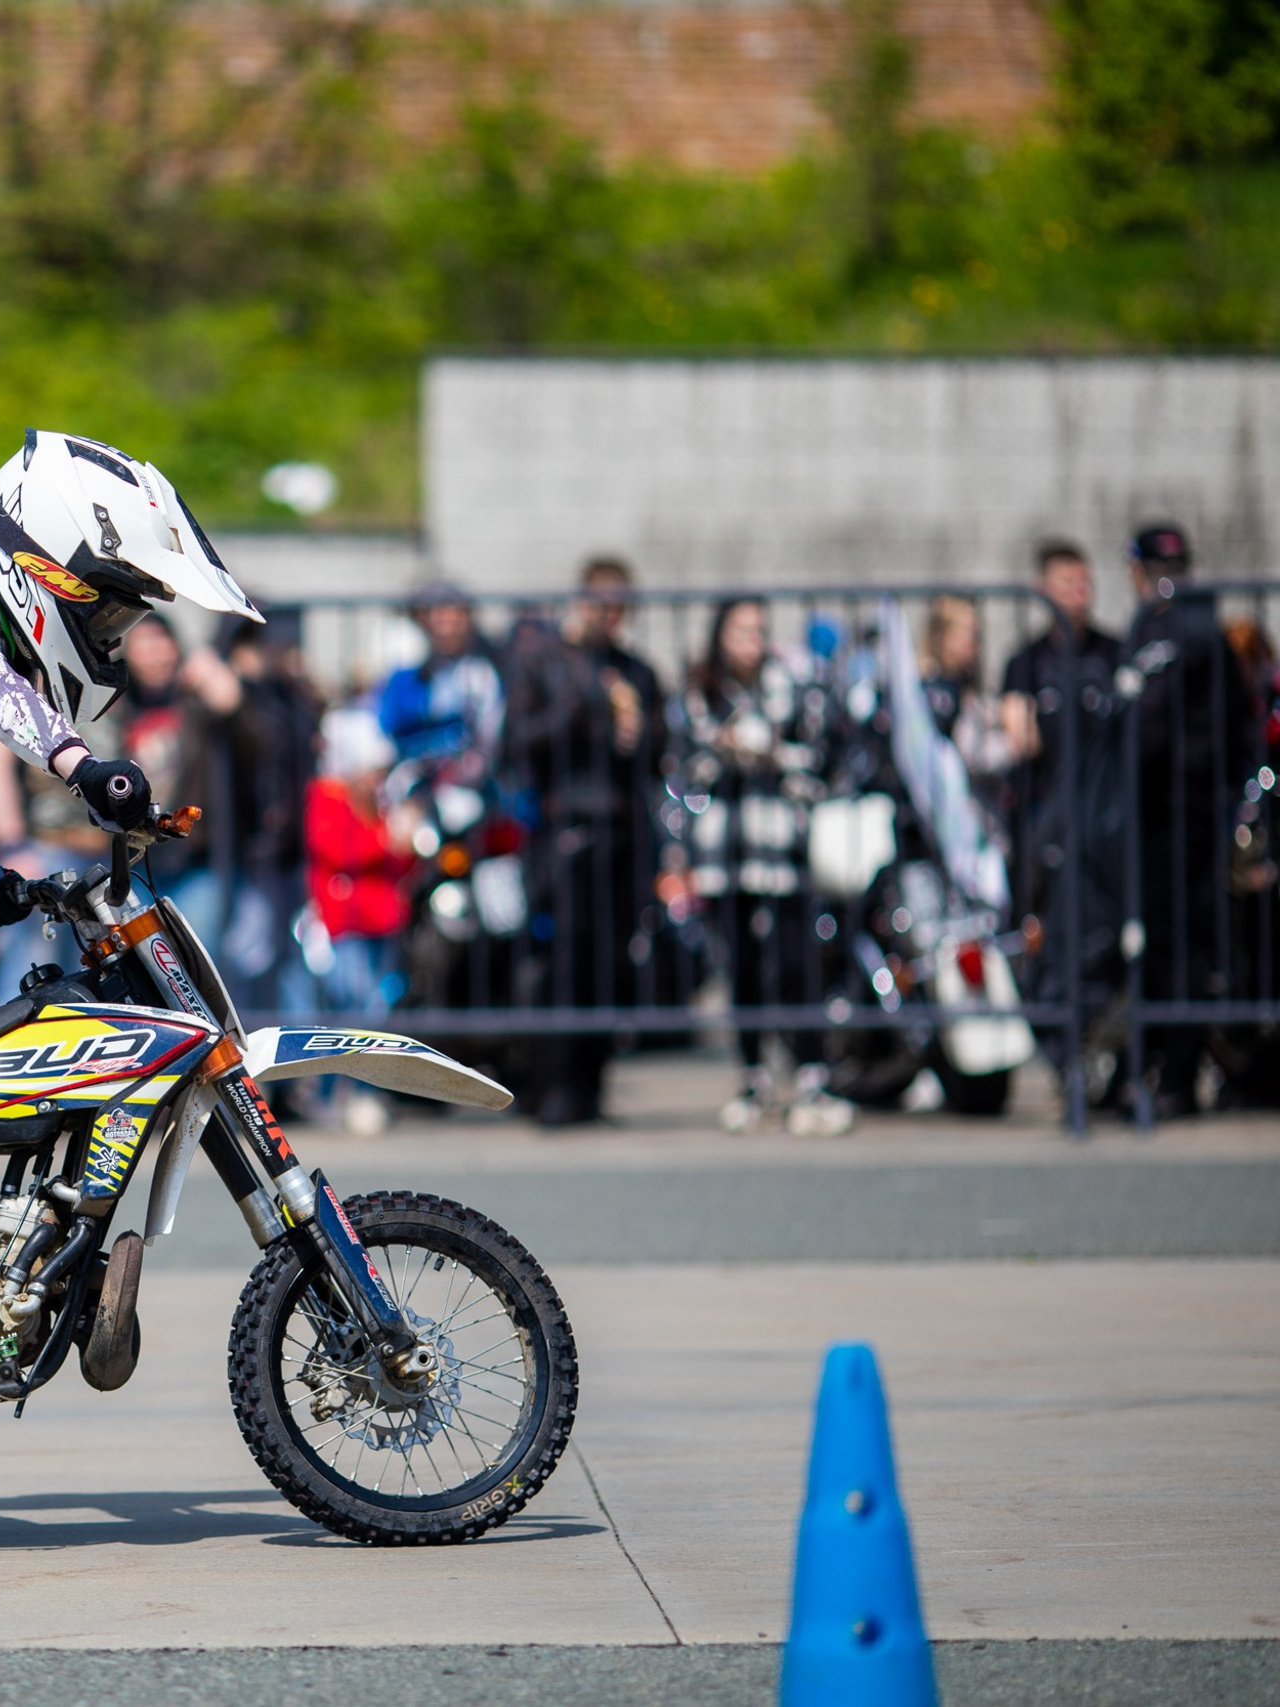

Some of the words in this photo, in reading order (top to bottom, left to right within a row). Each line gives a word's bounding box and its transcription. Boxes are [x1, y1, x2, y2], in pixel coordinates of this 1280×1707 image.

[14, 552, 99, 600] FMF
[303, 1035, 412, 1051] BUD
[226, 1083, 247, 1113] WORLD
[243, 1112, 272, 1157] CHAMPION
[235, 1079, 264, 1126] Tuning
[323, 1185, 360, 1244] BRAKING
[461, 1474, 524, 1521] X-GRIP
